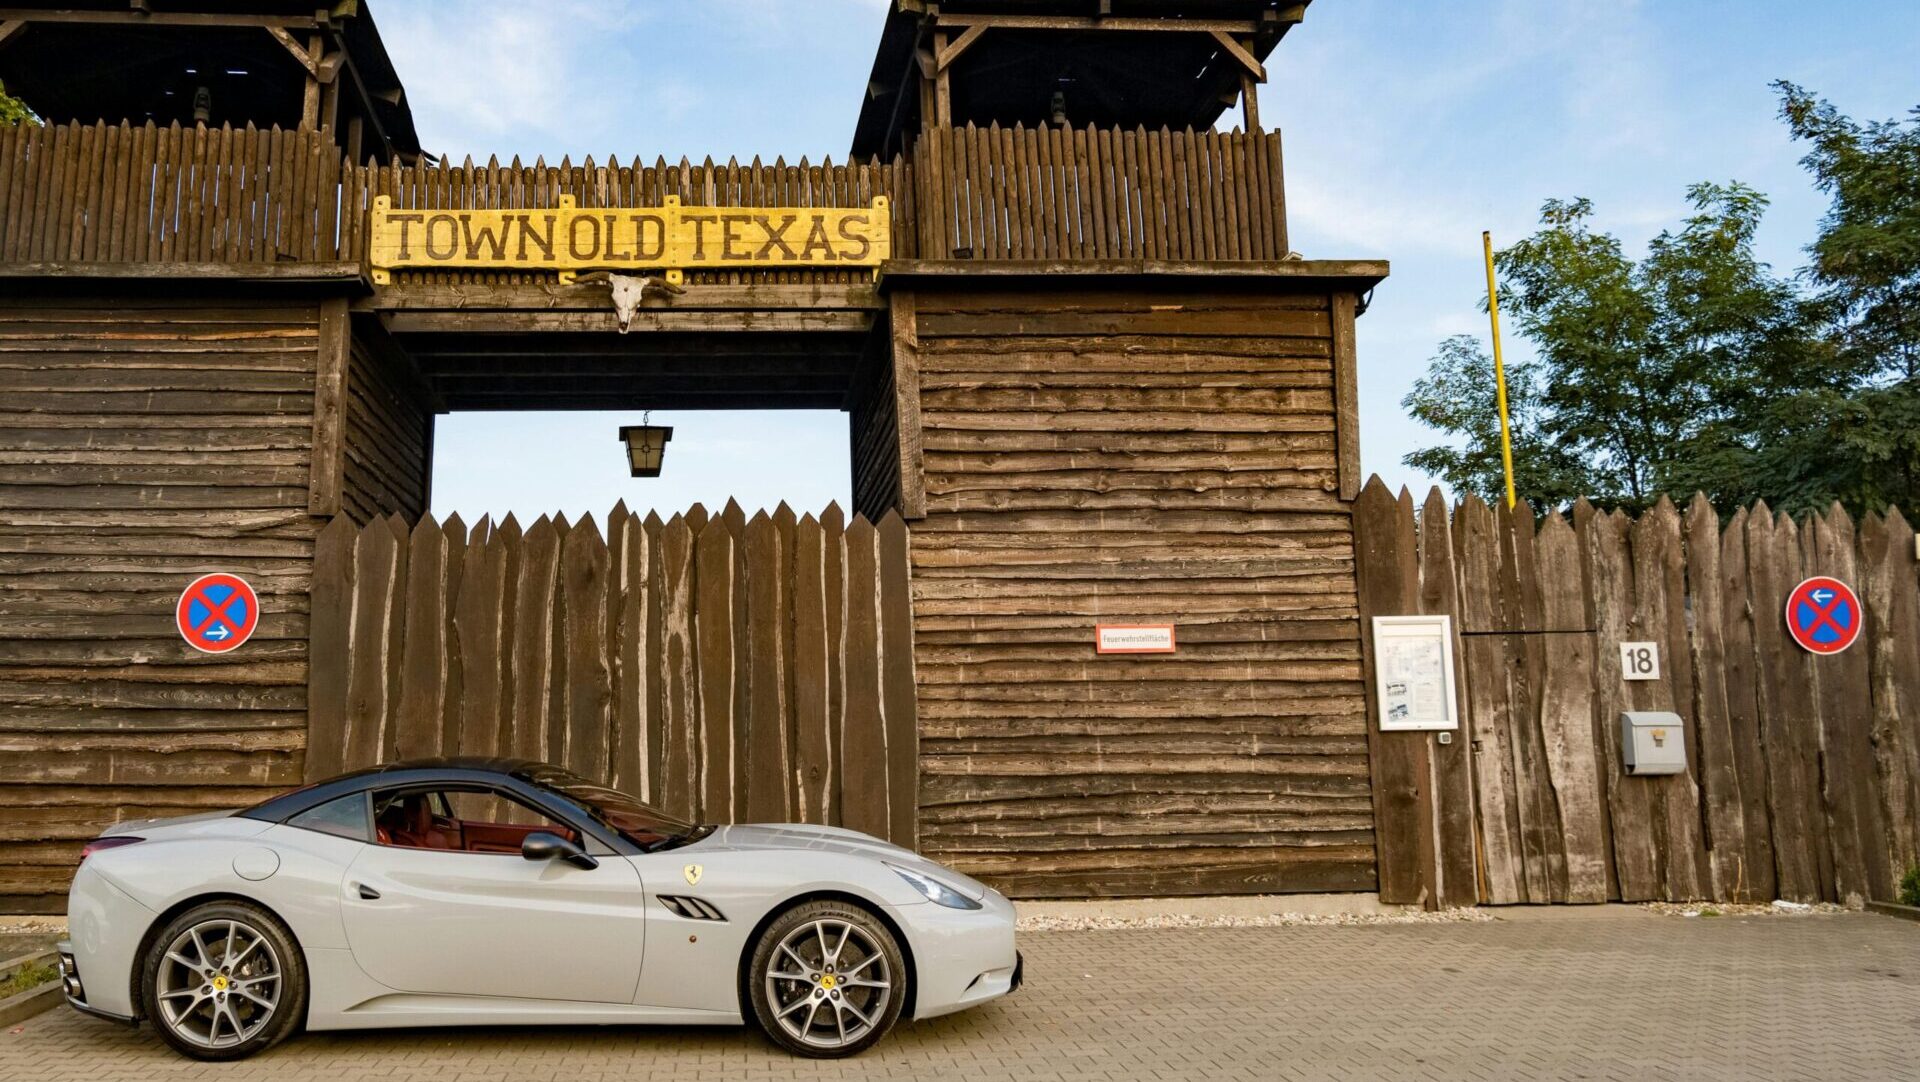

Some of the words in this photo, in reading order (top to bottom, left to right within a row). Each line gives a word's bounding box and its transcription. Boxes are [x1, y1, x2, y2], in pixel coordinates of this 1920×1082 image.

[386, 213, 557, 262] TOWN
[568, 214, 666, 262] OLD
[680, 214, 871, 263] TEXAS
[1626, 647, 1653, 674] 18
